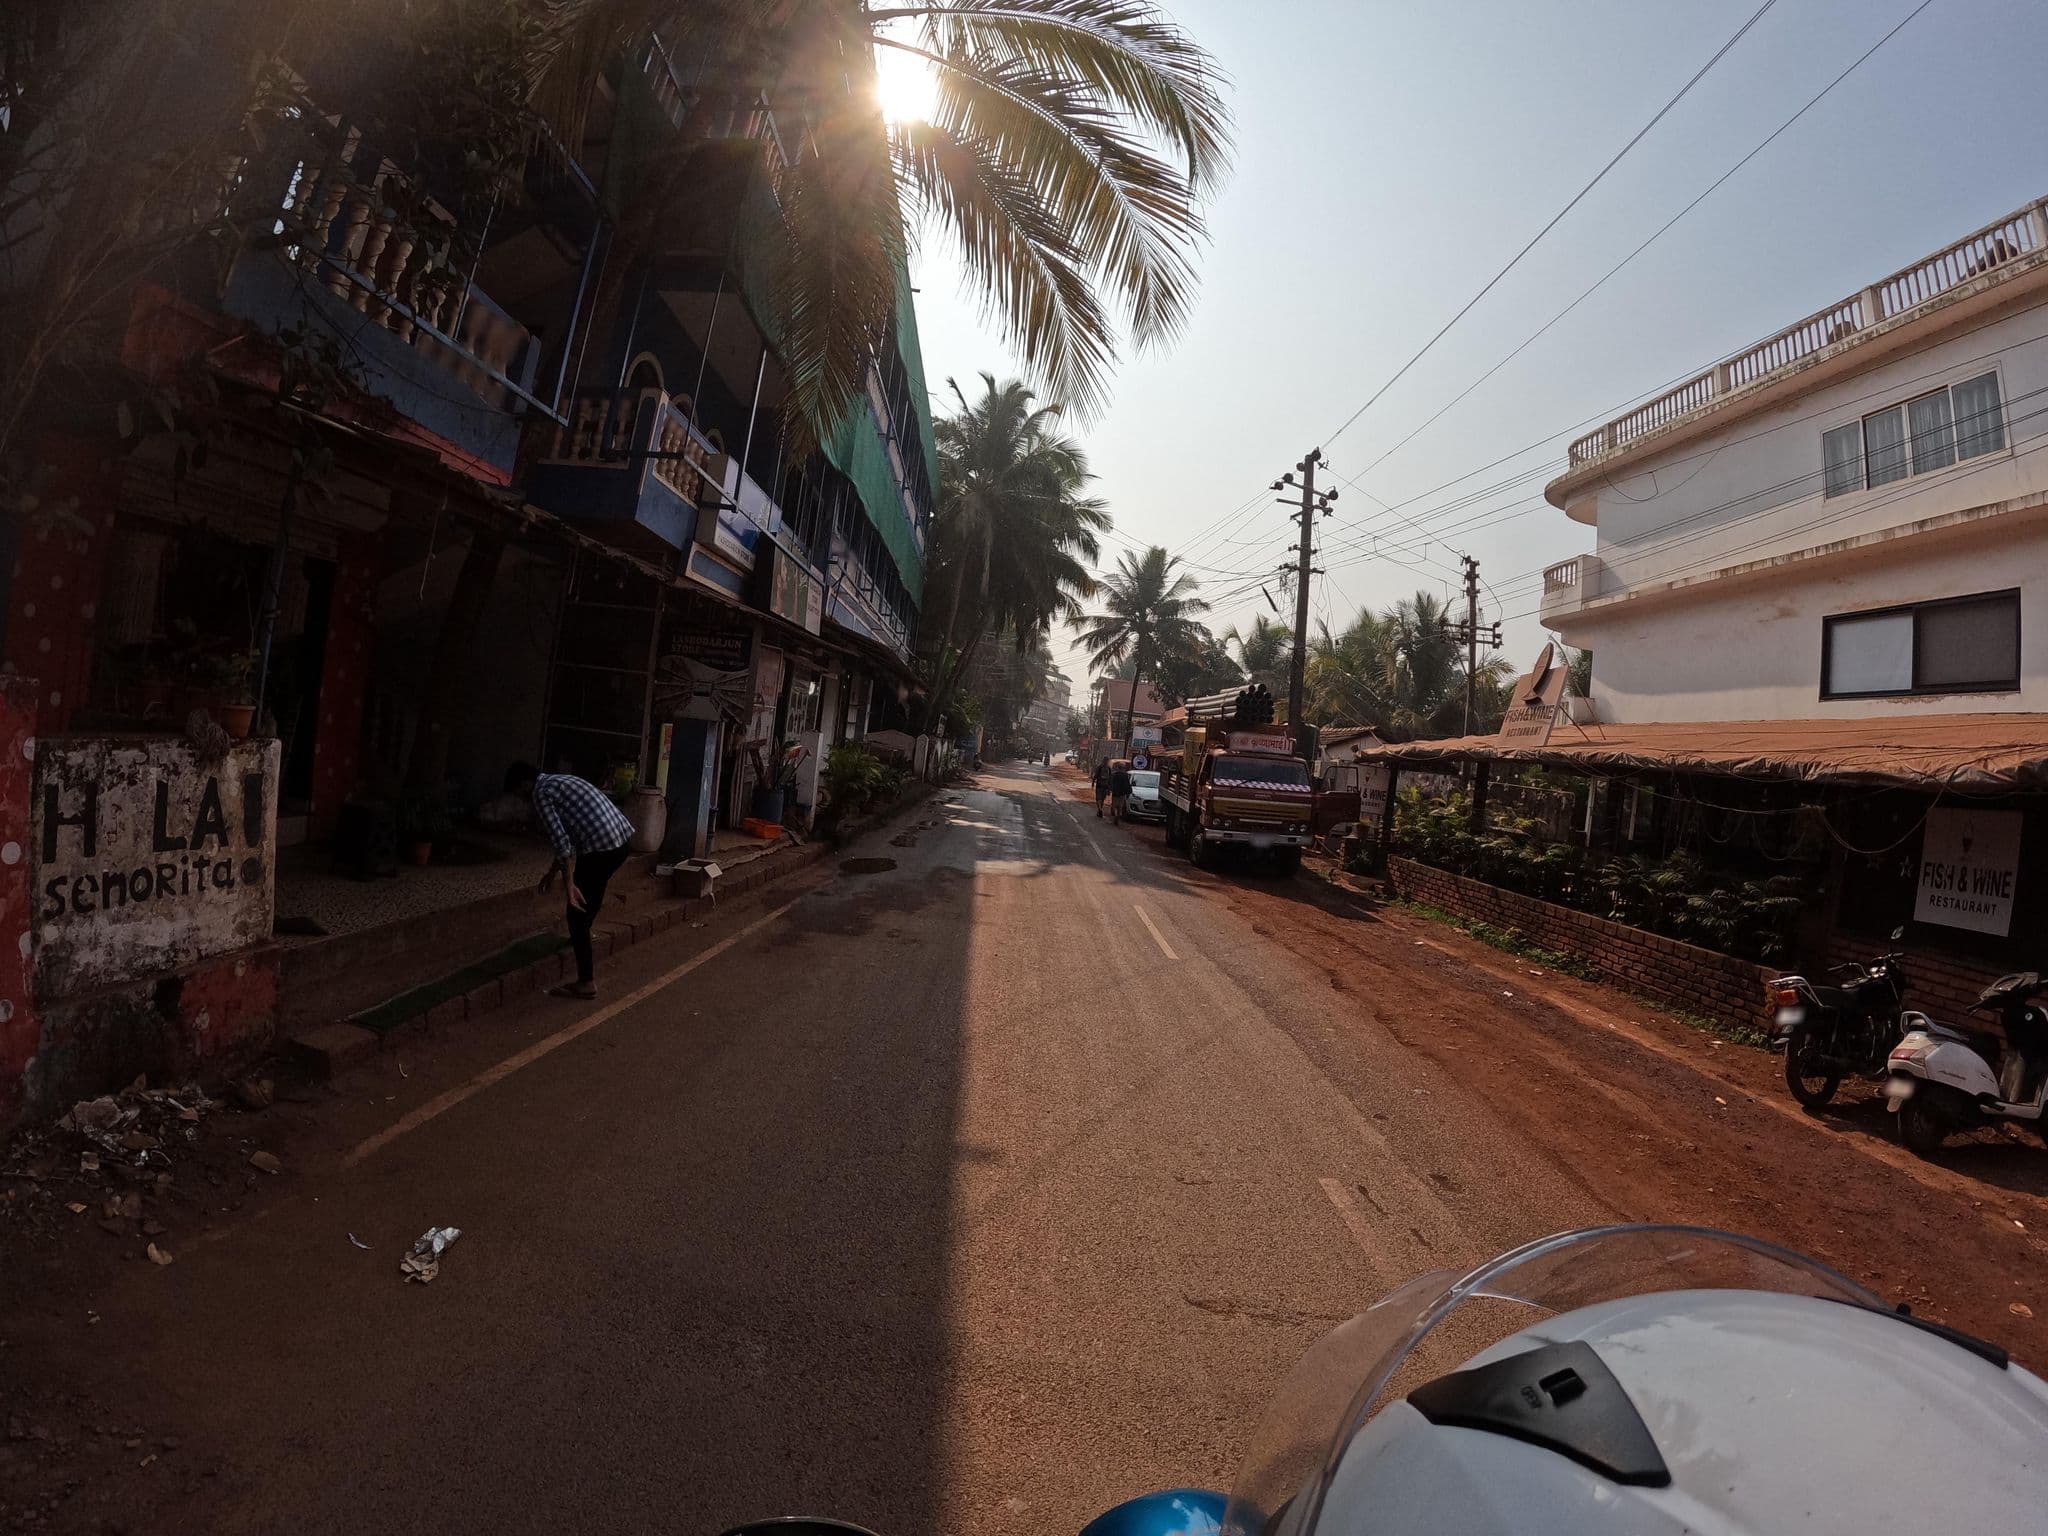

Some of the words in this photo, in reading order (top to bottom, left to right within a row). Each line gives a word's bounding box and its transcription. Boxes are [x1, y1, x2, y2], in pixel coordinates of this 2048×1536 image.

[1922, 862, 1954, 890] FISH
[1957, 866, 1968, 893] &
[1973, 868, 2013, 899] WINE
[1929, 894, 1997, 915] RESTAURANT
